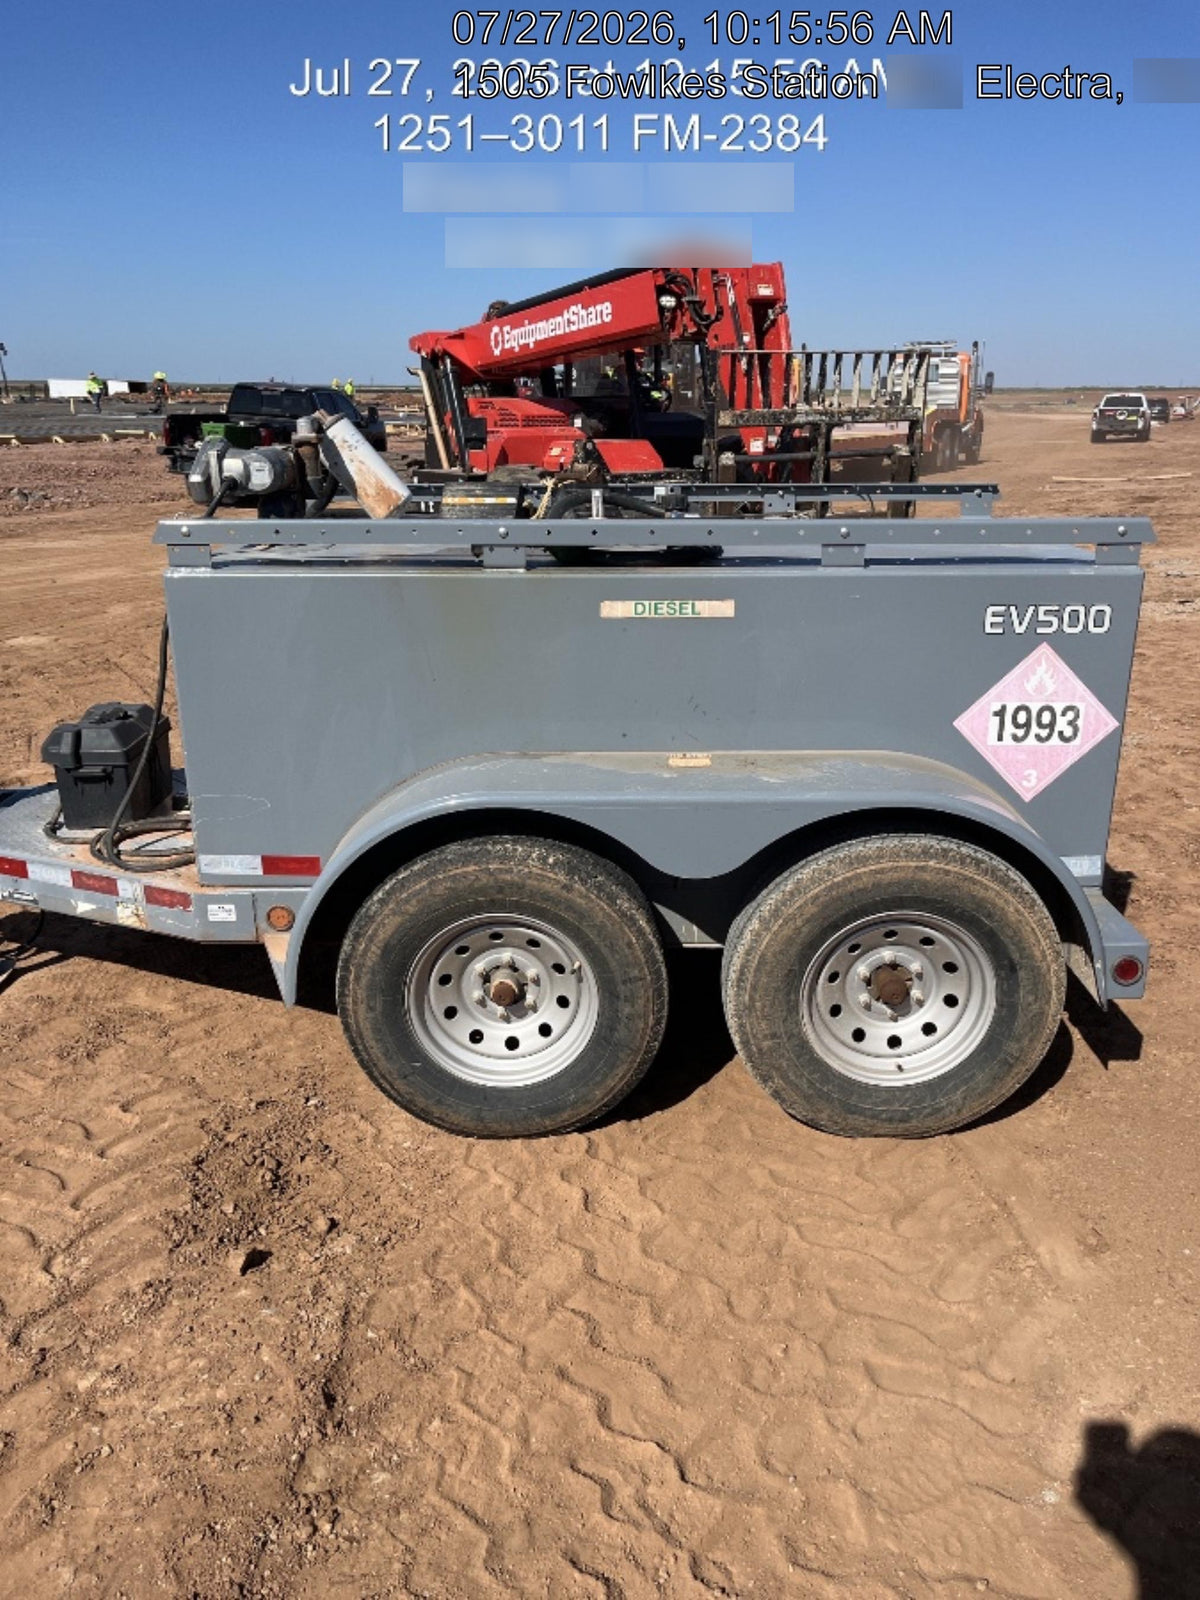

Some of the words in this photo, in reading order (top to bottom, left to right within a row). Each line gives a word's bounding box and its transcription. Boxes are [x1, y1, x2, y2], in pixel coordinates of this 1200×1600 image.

[503, 301, 612, 352] EquipmentShare
[634, 602, 701, 616] DIESEL
[984, 604, 1112, 634] EV500
[992, 704, 1080, 743] 1993
[1021, 769, 1038, 788] 3
